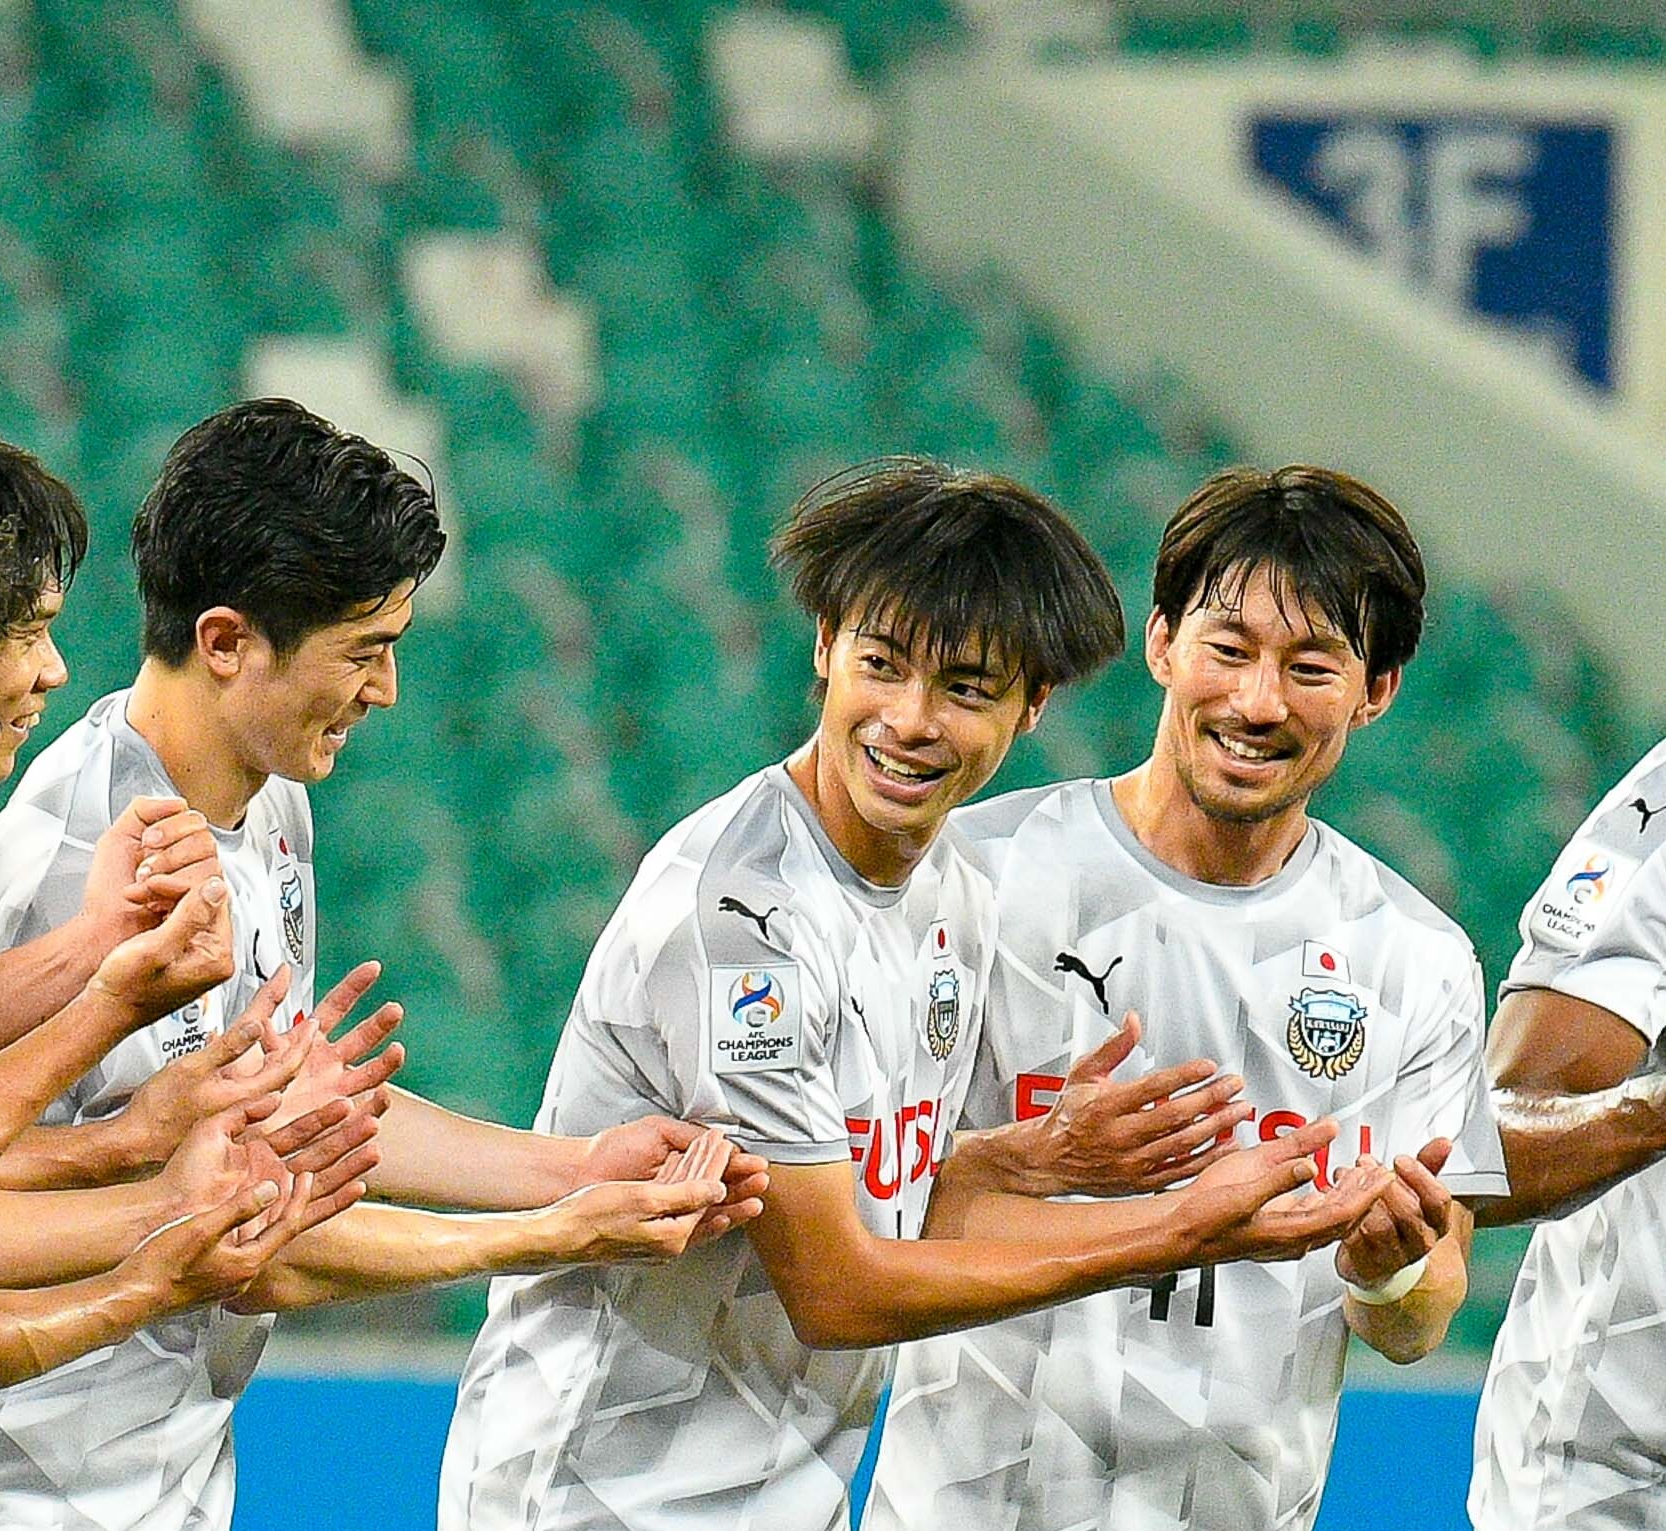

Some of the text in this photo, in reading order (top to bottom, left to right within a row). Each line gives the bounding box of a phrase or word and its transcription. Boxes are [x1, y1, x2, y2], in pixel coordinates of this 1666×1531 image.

[747, 1031, 766, 1039] AFC
[717, 1036, 794, 1051] CHAMPIONS
[730, 1048, 783, 1062] LEAGUE
